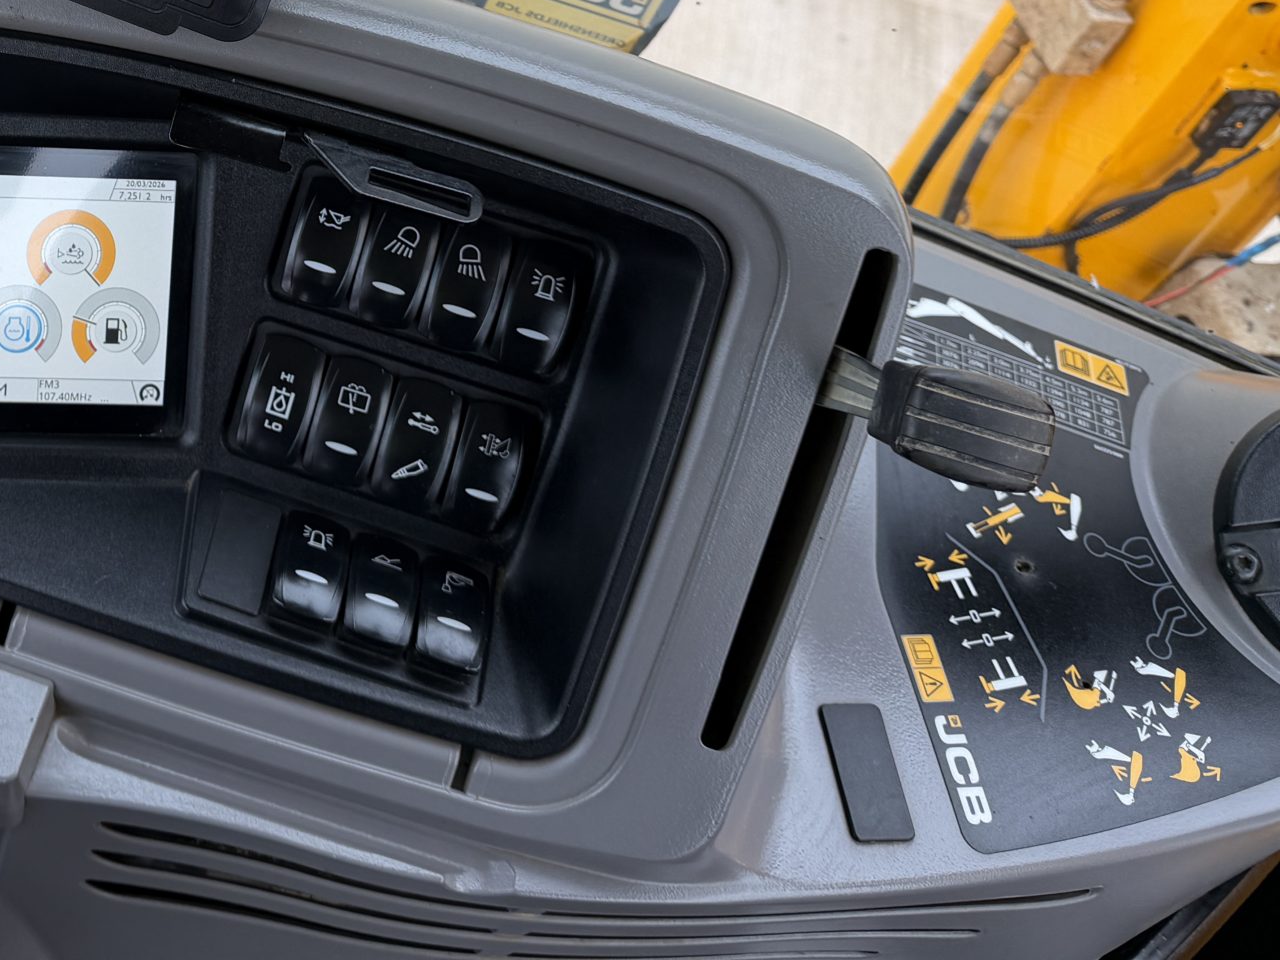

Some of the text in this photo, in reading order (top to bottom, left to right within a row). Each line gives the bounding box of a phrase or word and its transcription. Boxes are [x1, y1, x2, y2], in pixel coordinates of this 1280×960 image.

[160, 193, 172, 201] hrs
[280, 371, 295, 384] HI
[39, 379, 60, 390] FM3
[39, 392, 93, 403] 107.40MHz
[263, 418, 283, 432] LO
[934, 714, 993, 825] JCB
